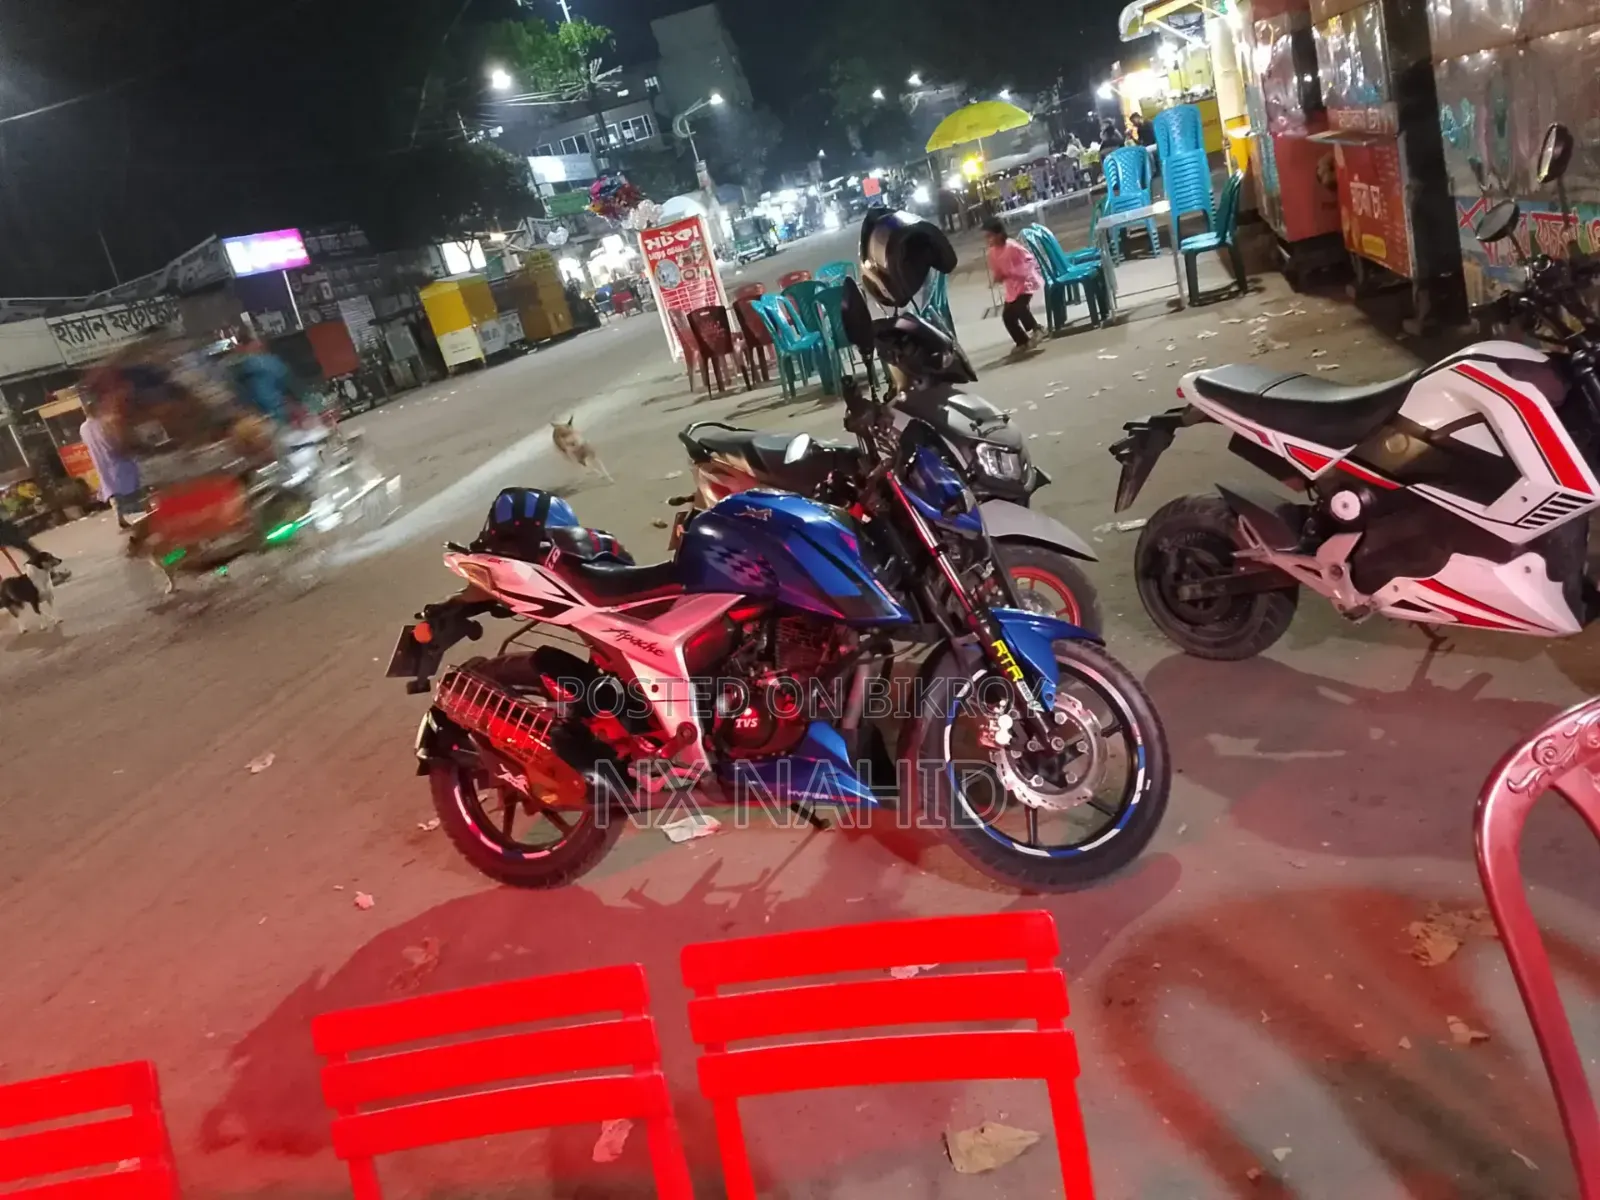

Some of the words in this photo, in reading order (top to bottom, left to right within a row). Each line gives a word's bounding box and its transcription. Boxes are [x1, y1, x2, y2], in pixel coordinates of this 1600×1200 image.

[644, 225, 700, 251] মটকা
[50, 313, 111, 346] হাসান
[600, 627, 665, 658] Apache
[991, 640, 1024, 682] RTR
[735, 717, 759, 729] TVS
